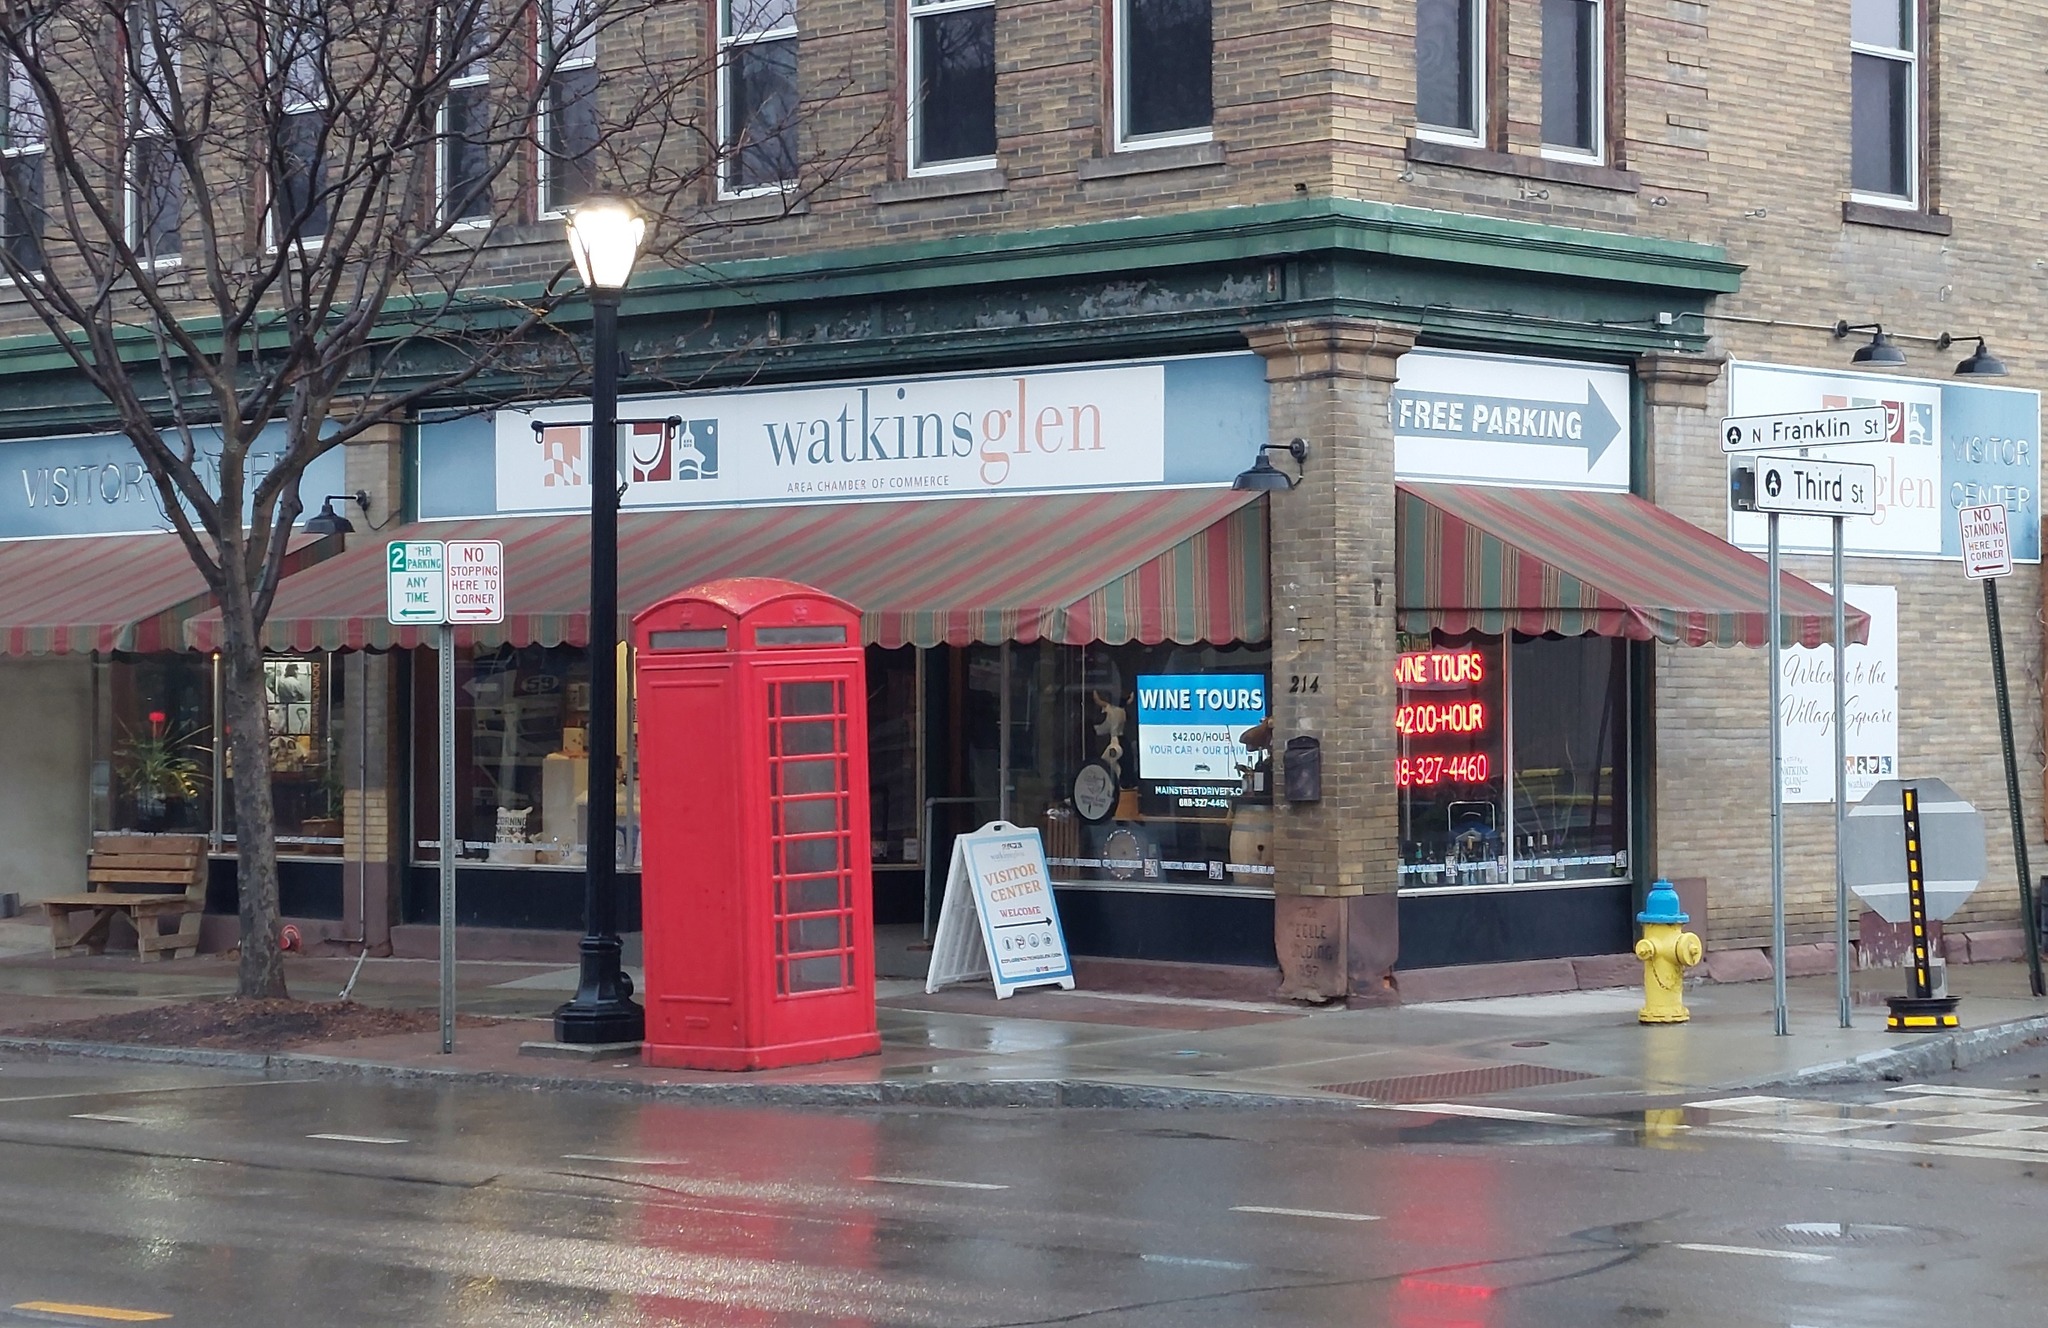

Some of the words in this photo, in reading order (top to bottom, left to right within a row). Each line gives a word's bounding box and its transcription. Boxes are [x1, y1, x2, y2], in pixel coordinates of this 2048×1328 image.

[1399, 399, 1464, 433] FREE
[1471, 404, 1582, 440] PARKING
[1752, 427, 1762, 443] N
[1773, 417, 1850, 441] Franklin
[1864, 419, 1878, 435] St
[1951, 435, 2031, 467] VISITOR
[22, 463, 146, 508] VISITOR
[787, 479, 813, 493] AREA
[817, 478, 868, 492] CHAMBER
[872, 477, 885, 489] OF
[889, 475, 950, 488] COMMERCE
[1793, 470, 1842, 502] Third
[1851, 484, 1864, 504] St
[1950, 481, 2031, 514] CENTER
[1973, 508, 1991, 523] NO
[1964, 521, 2004, 539] STANDING
[1968, 541, 1990, 551] HERE
[1993, 538, 2004, 548] TO
[391, 547, 405, 568] 2
[417, 546, 432, 556] HR
[407, 558, 441, 569] PARKING
[464, 547, 484, 562] NO
[1970, 549, 2004, 562] CORNER
[450, 566, 498, 576] STOPPING
[406, 577, 428, 588] ANY
[452, 580, 479, 590] HERE
[484, 580, 497, 590] TO
[405, 592, 430, 603] TIME
[455, 594, 495, 604] CORNER
[1431, 653, 1483, 683] TOURS
[1783, 654, 1849, 687] Welcoe
[1853, 661, 1864, 686] to
[1867, 661, 1886, 685] the
[1289, 674, 1319, 693] 214
[1139, 688, 1191, 710] WINE
[1195, 688, 1263, 710] TOURS
[1149, 745, 1172, 755] YOUR
[1175, 745, 1192, 755] CAR
[1204, 746, 1221, 755] OUR
[983, 863, 1038, 886] VISITOR
[990, 879, 1042, 903] CENTER
[1000, 906, 1042, 918] WELCOME
